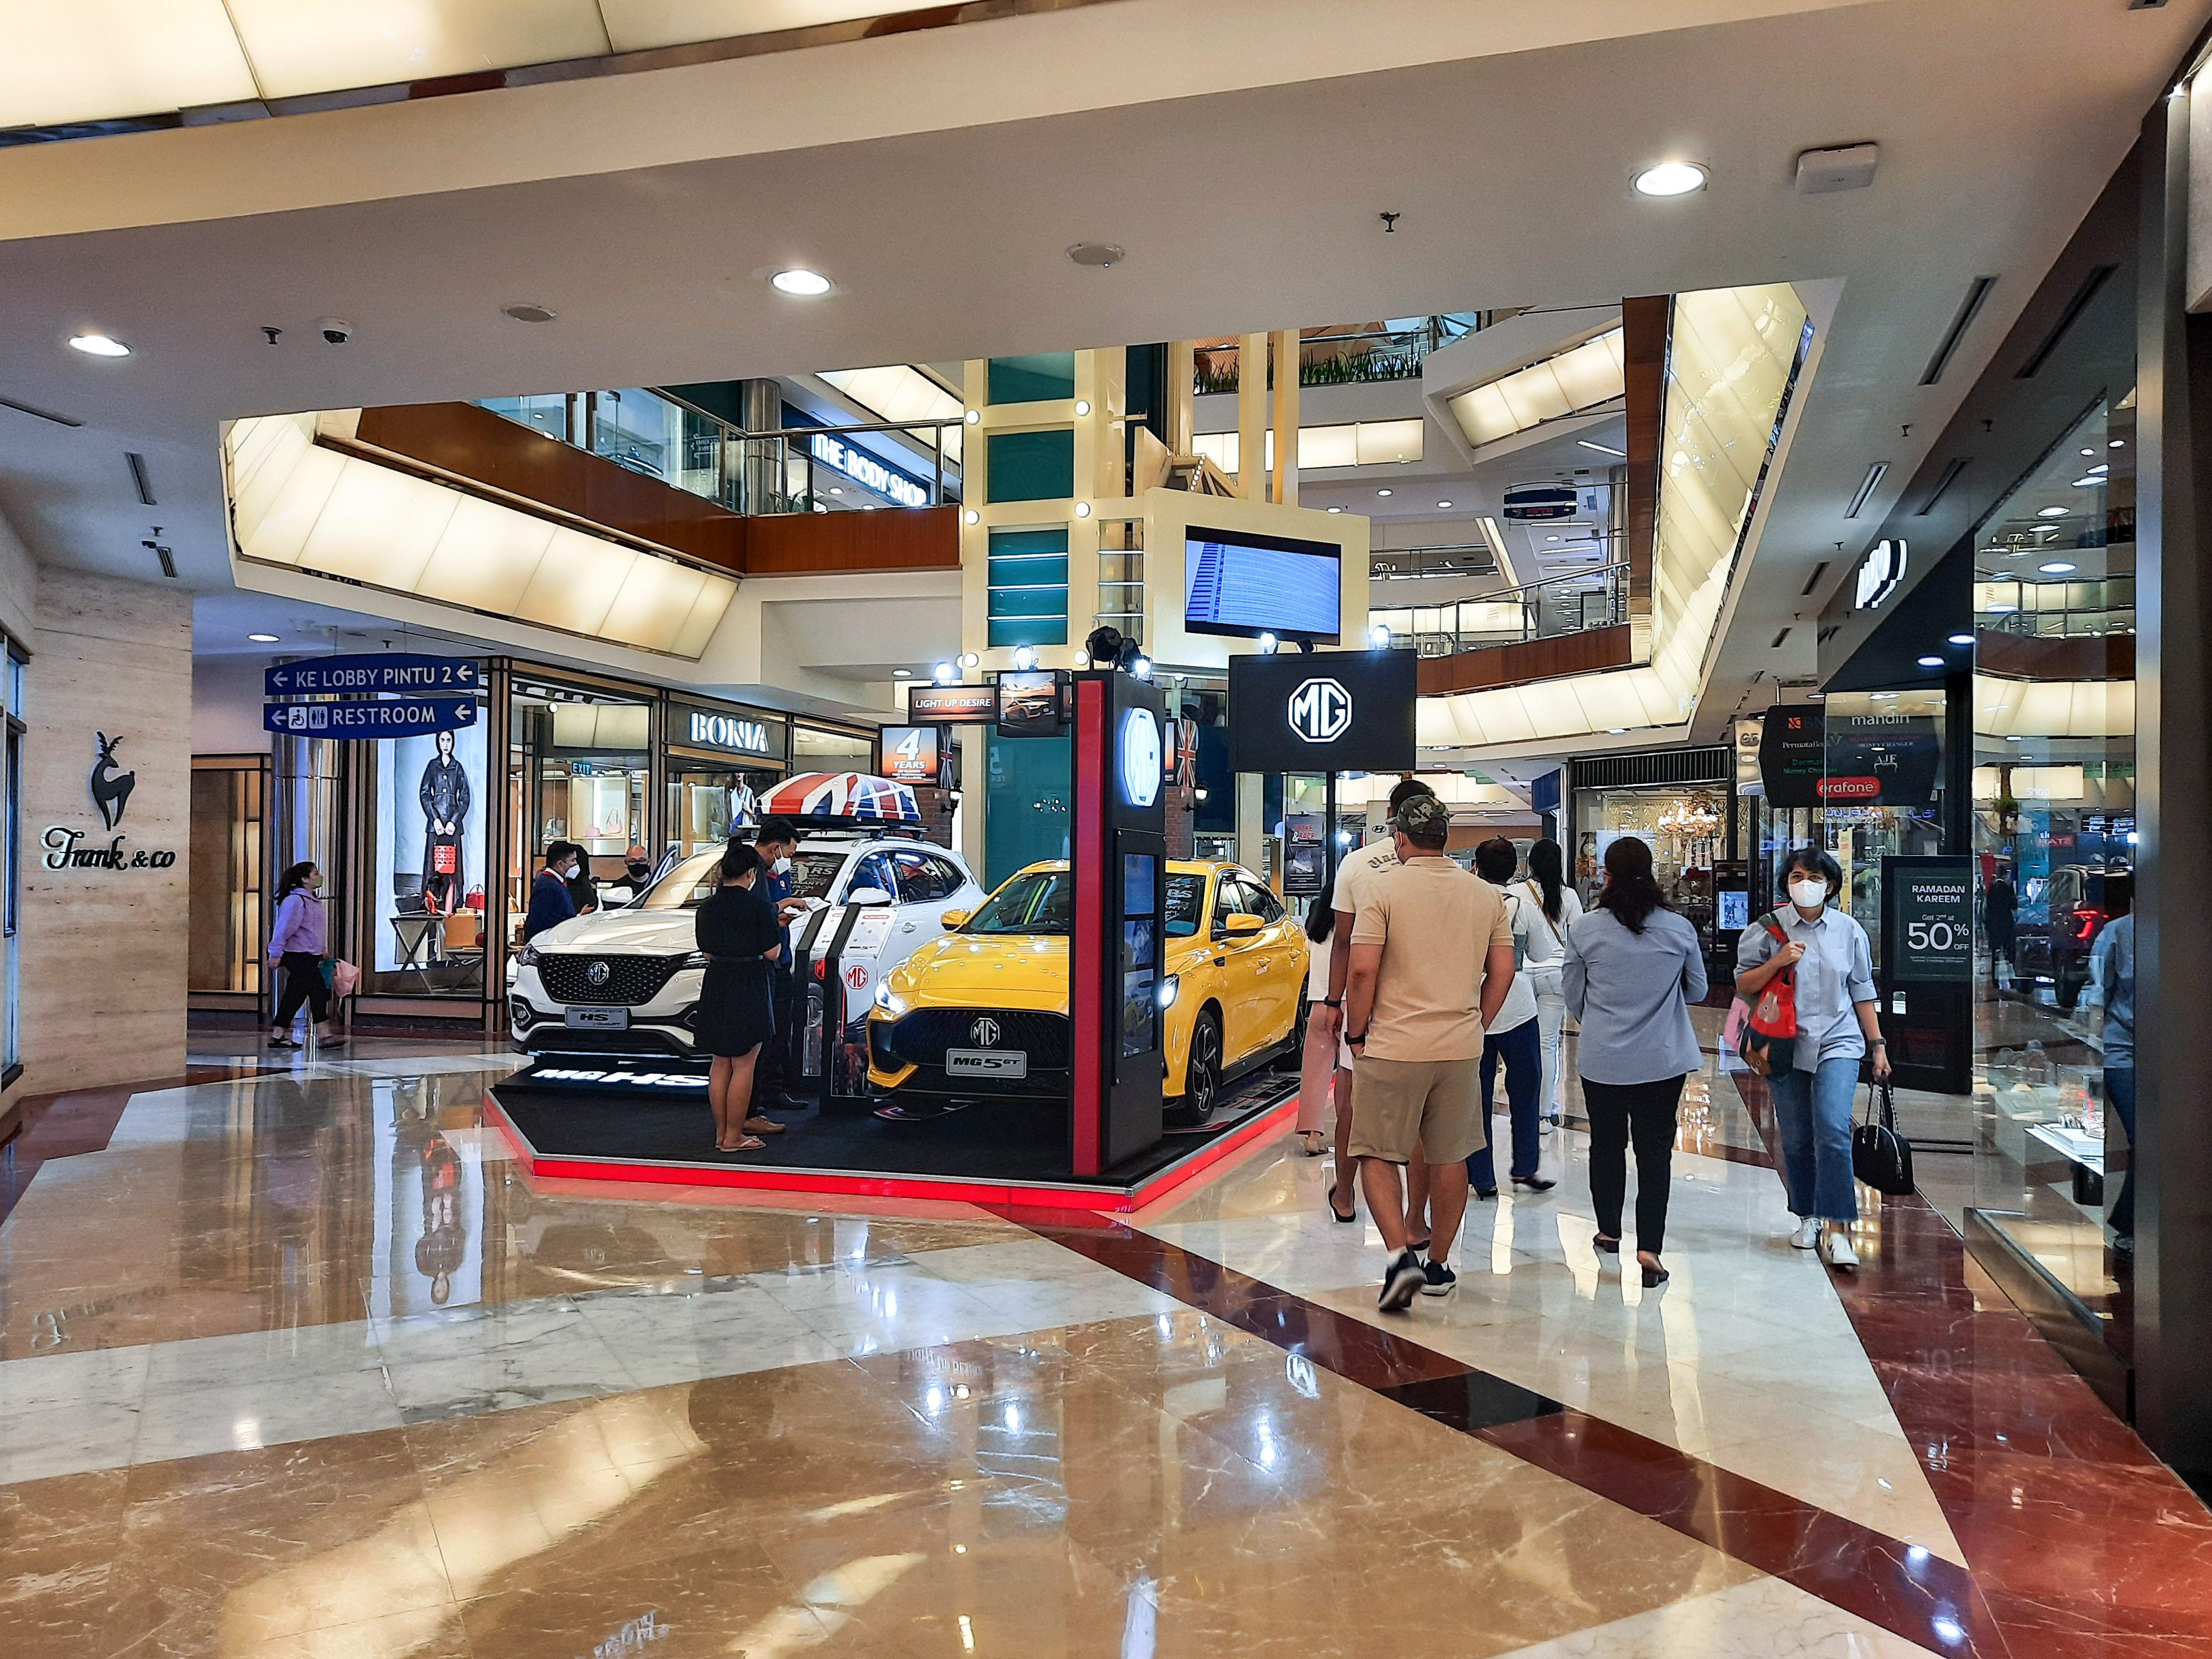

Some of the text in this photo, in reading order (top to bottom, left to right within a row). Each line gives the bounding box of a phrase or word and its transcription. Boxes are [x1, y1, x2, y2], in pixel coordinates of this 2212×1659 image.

[811, 433, 927, 507] THE BODY SHOP
[296, 666, 452, 687] KE LOBBY PINTU 2
[915, 698, 992, 708] LIGHT UP DESIRE
[1292, 682, 1348, 739] MG
[333, 706, 436, 726] RESTROOM
[690, 712, 770, 753] BONIA
[895, 728, 921, 761] 4
[572, 763, 591, 774] EXIT
[893, 760, 926, 769] YEARS
[2026, 787, 2051, 797] Shop
[44, 827, 128, 870] Frank
[1912, 885, 1965, 893] RAMADAN
[1917, 895, 1960, 903] KAREEM
[847, 967, 867, 988] MG
[579, 1013, 609, 1021] HS
[972, 1020, 998, 1046] MG
